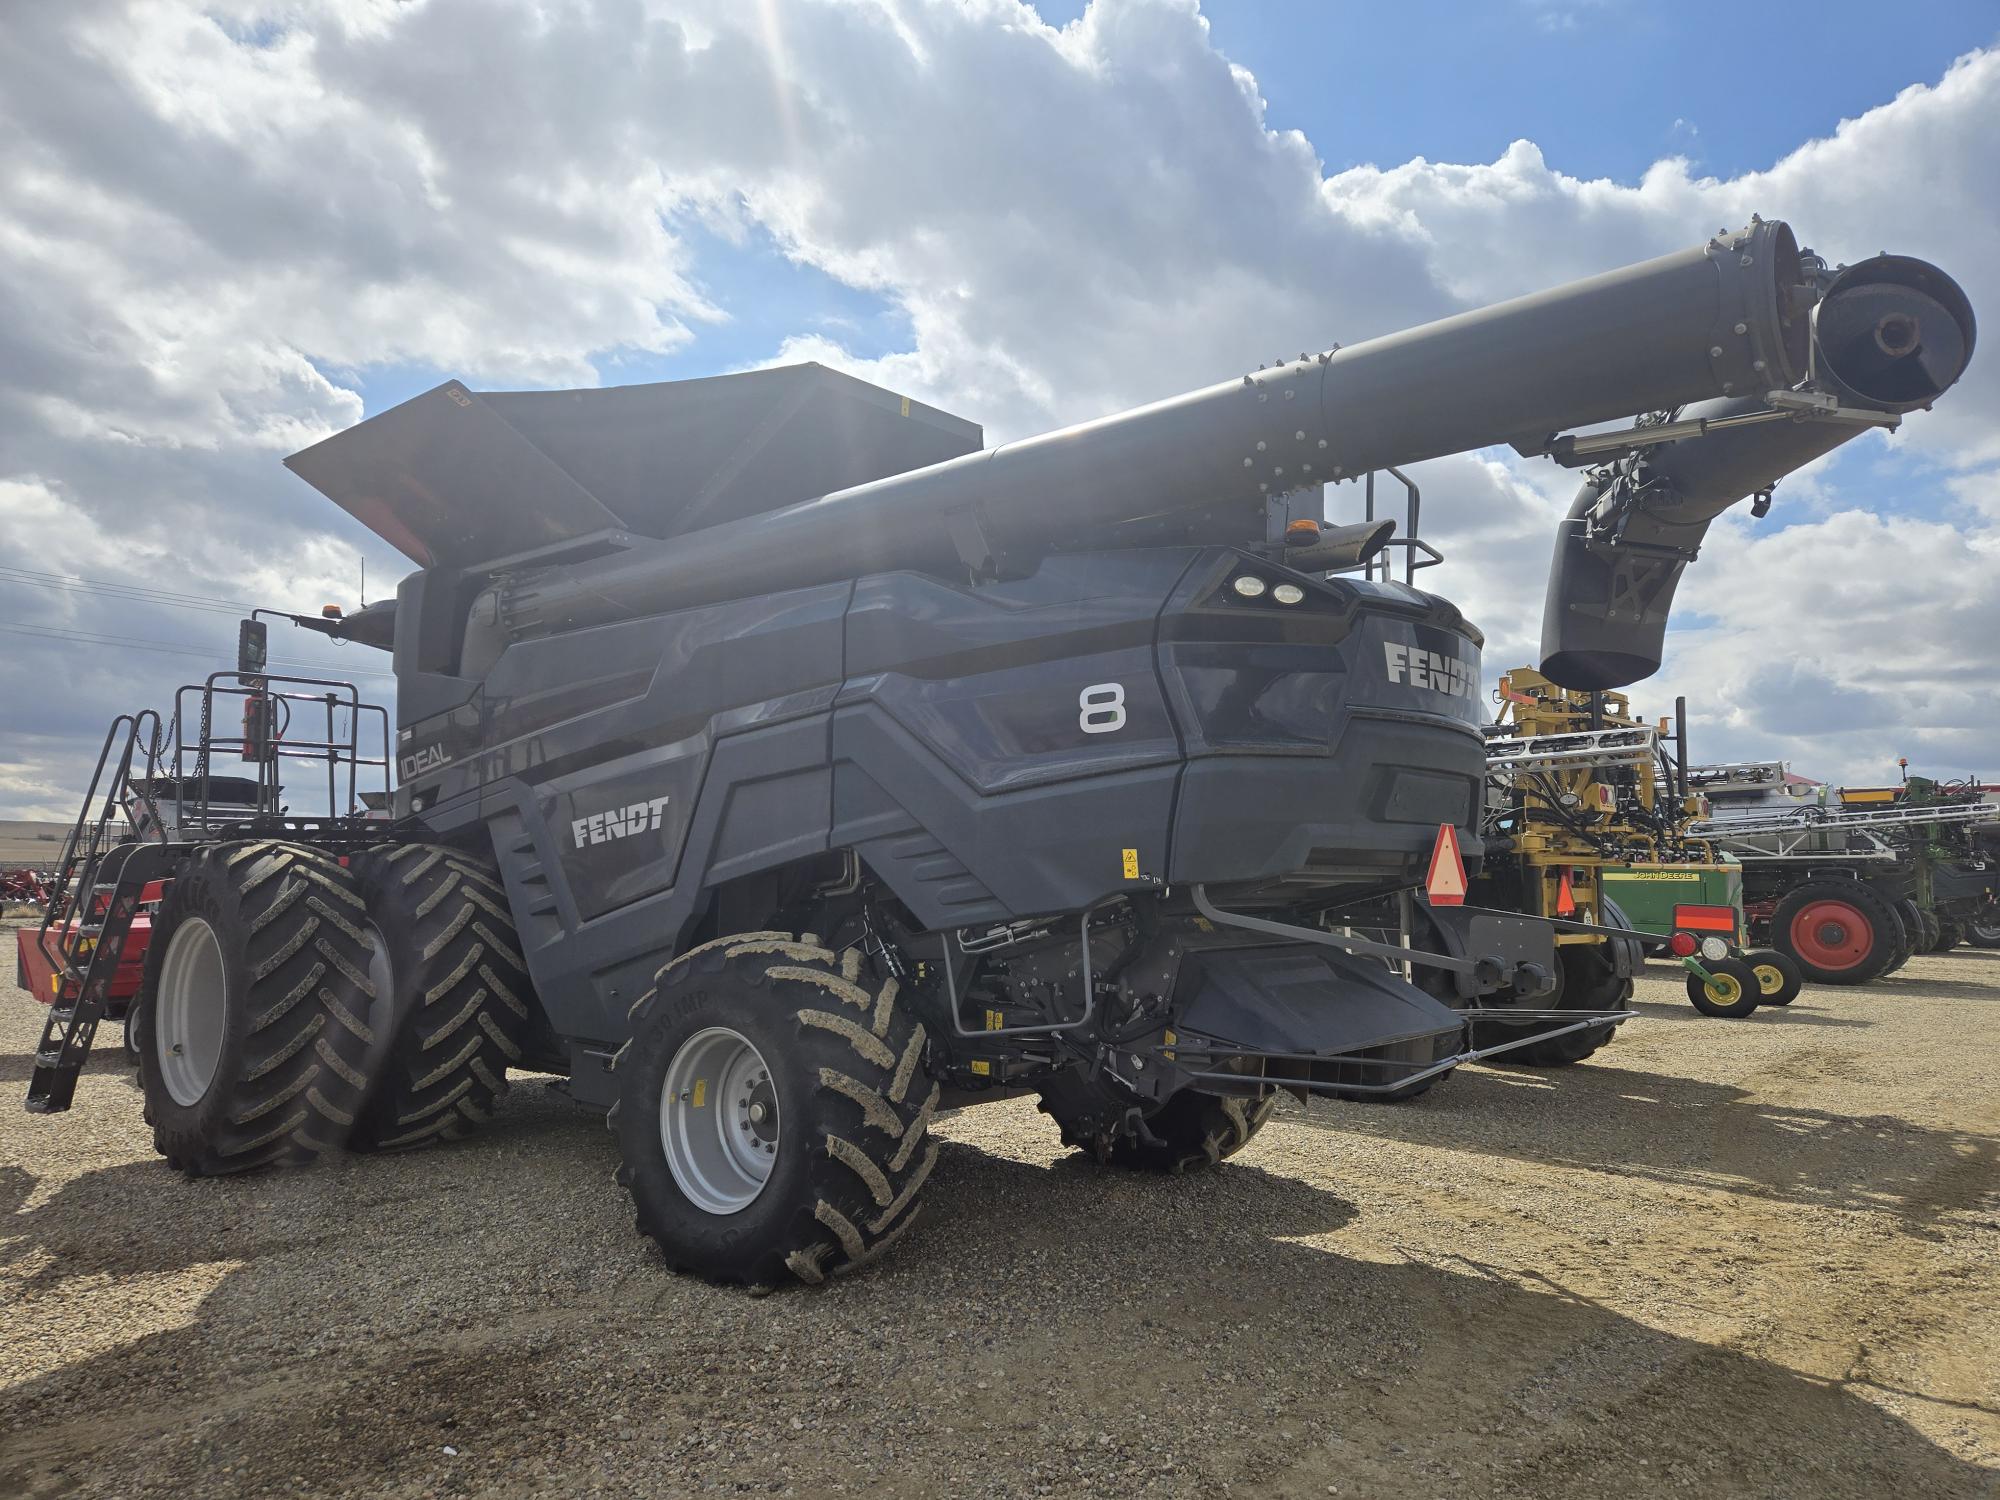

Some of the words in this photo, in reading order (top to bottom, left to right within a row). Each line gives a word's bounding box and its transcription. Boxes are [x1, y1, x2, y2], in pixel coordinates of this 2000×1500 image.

[1080, 683, 1126, 734] 8
[401, 742, 452, 780] IDEAL
[571, 796, 669, 849] FENDT
[1633, 871, 1659, 880] JOHN
[1660, 871, 1694, 880] DEERE
